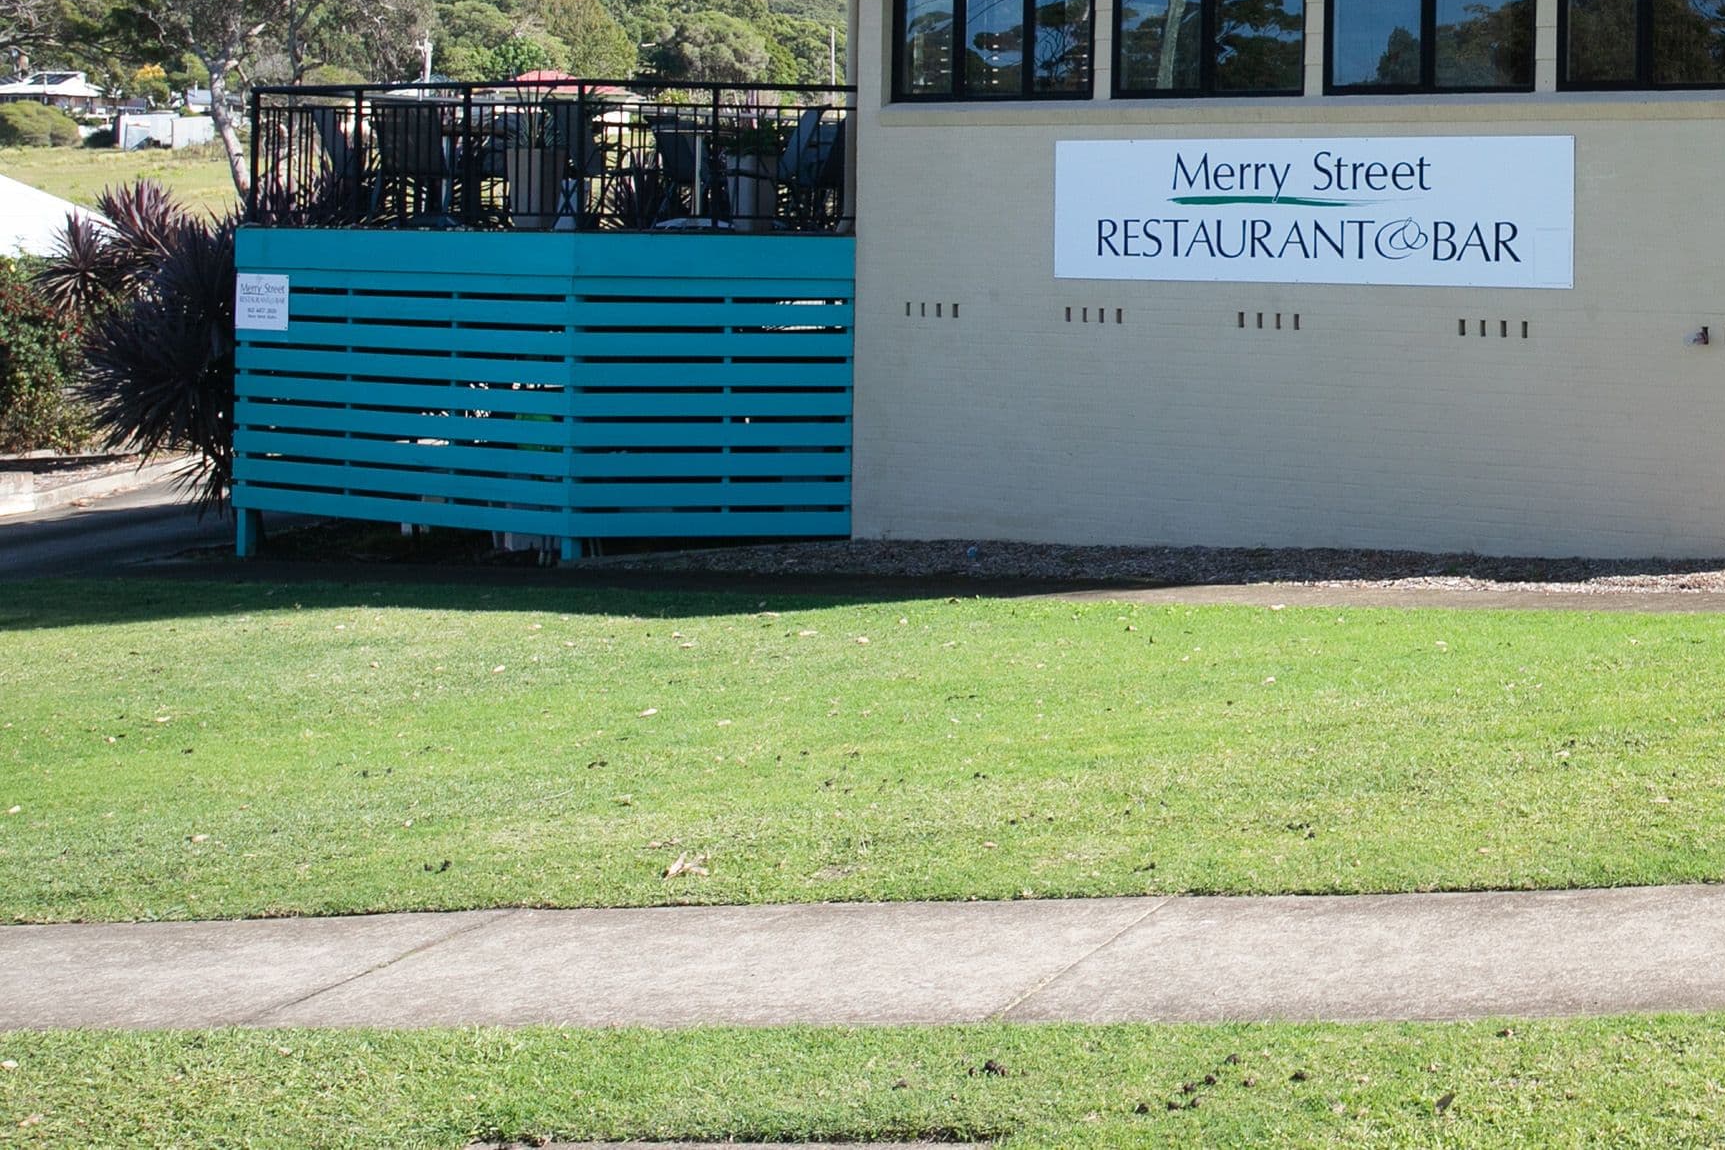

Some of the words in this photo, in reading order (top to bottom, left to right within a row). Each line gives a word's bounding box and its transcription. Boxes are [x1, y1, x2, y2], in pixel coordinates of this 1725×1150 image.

[1172, 152, 1292, 203] Merry
[1313, 151, 1432, 191] Street
[240, 283, 263, 295] Merry
[264, 282, 285, 294] Street
